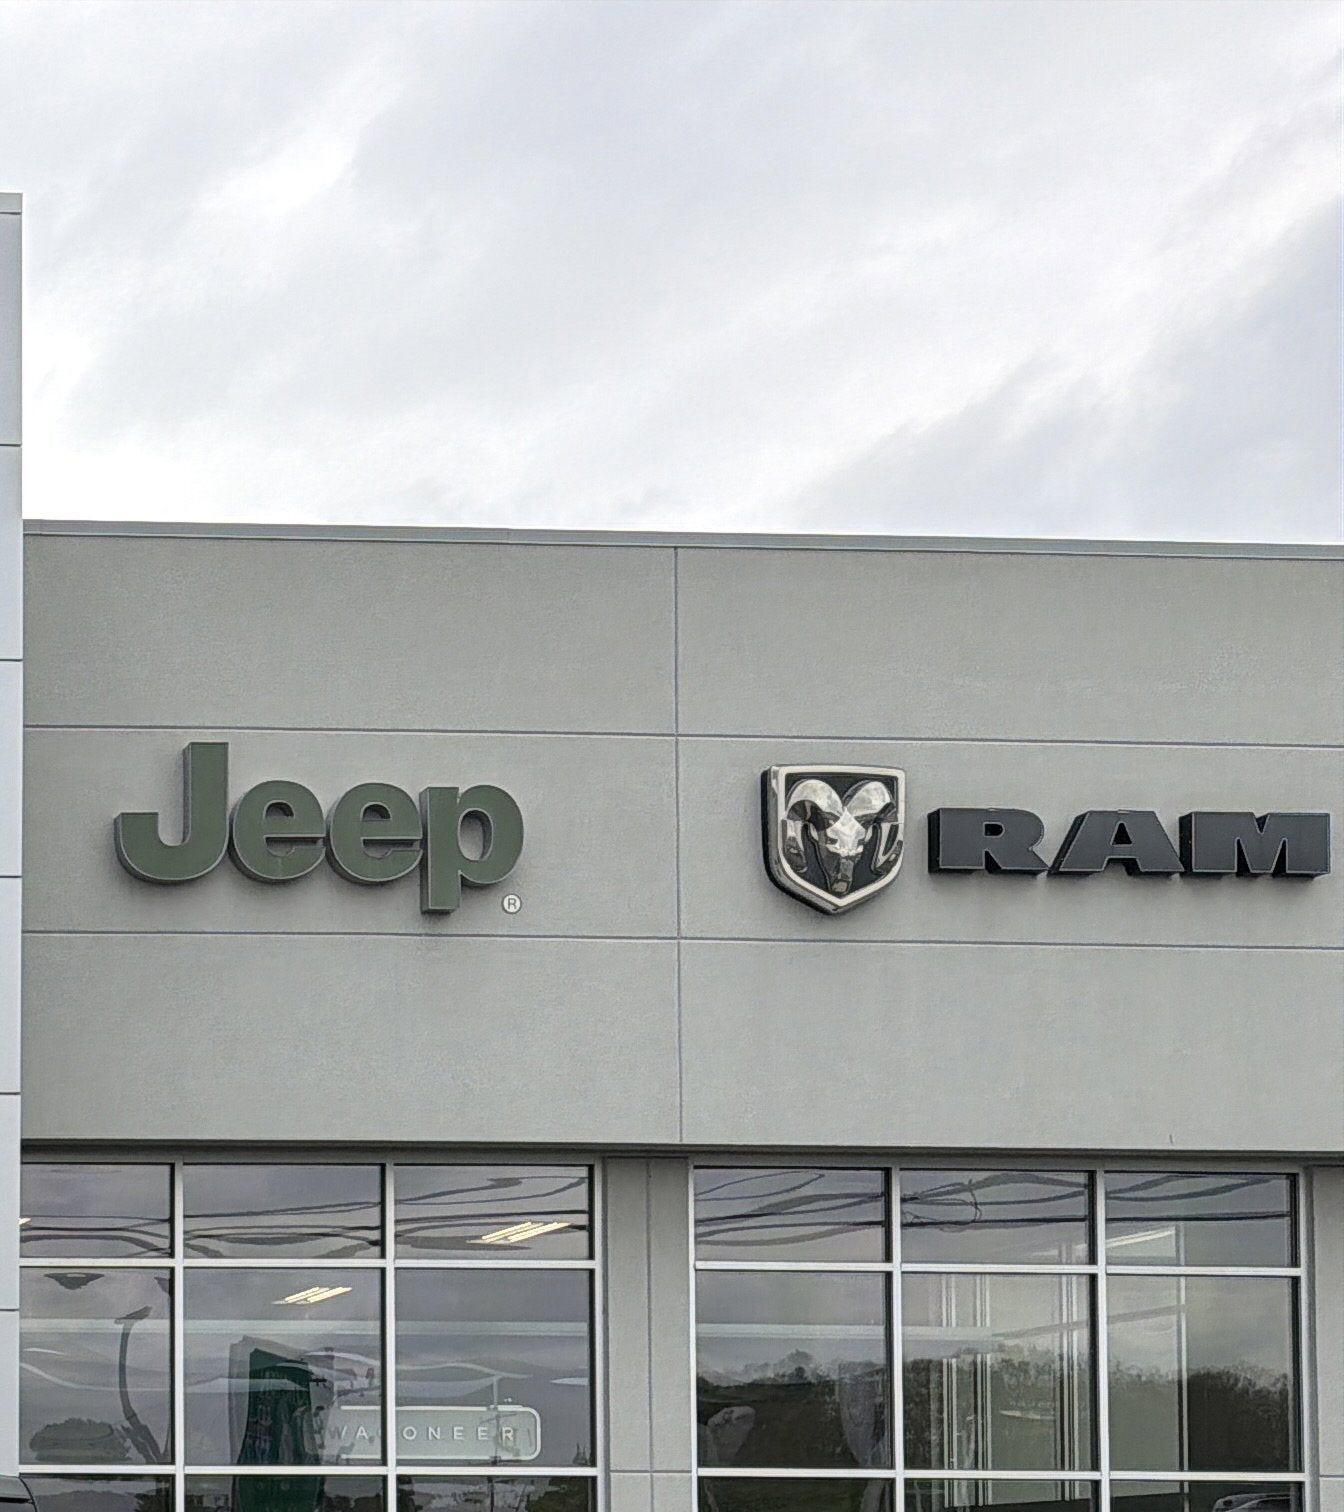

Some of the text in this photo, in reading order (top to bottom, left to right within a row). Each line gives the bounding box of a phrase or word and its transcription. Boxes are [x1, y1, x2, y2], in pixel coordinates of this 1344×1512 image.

[113, 741, 524, 914] Jeep
[927, 808, 1332, 878] RAM
[330, 1426, 514, 1441] WAONEER
